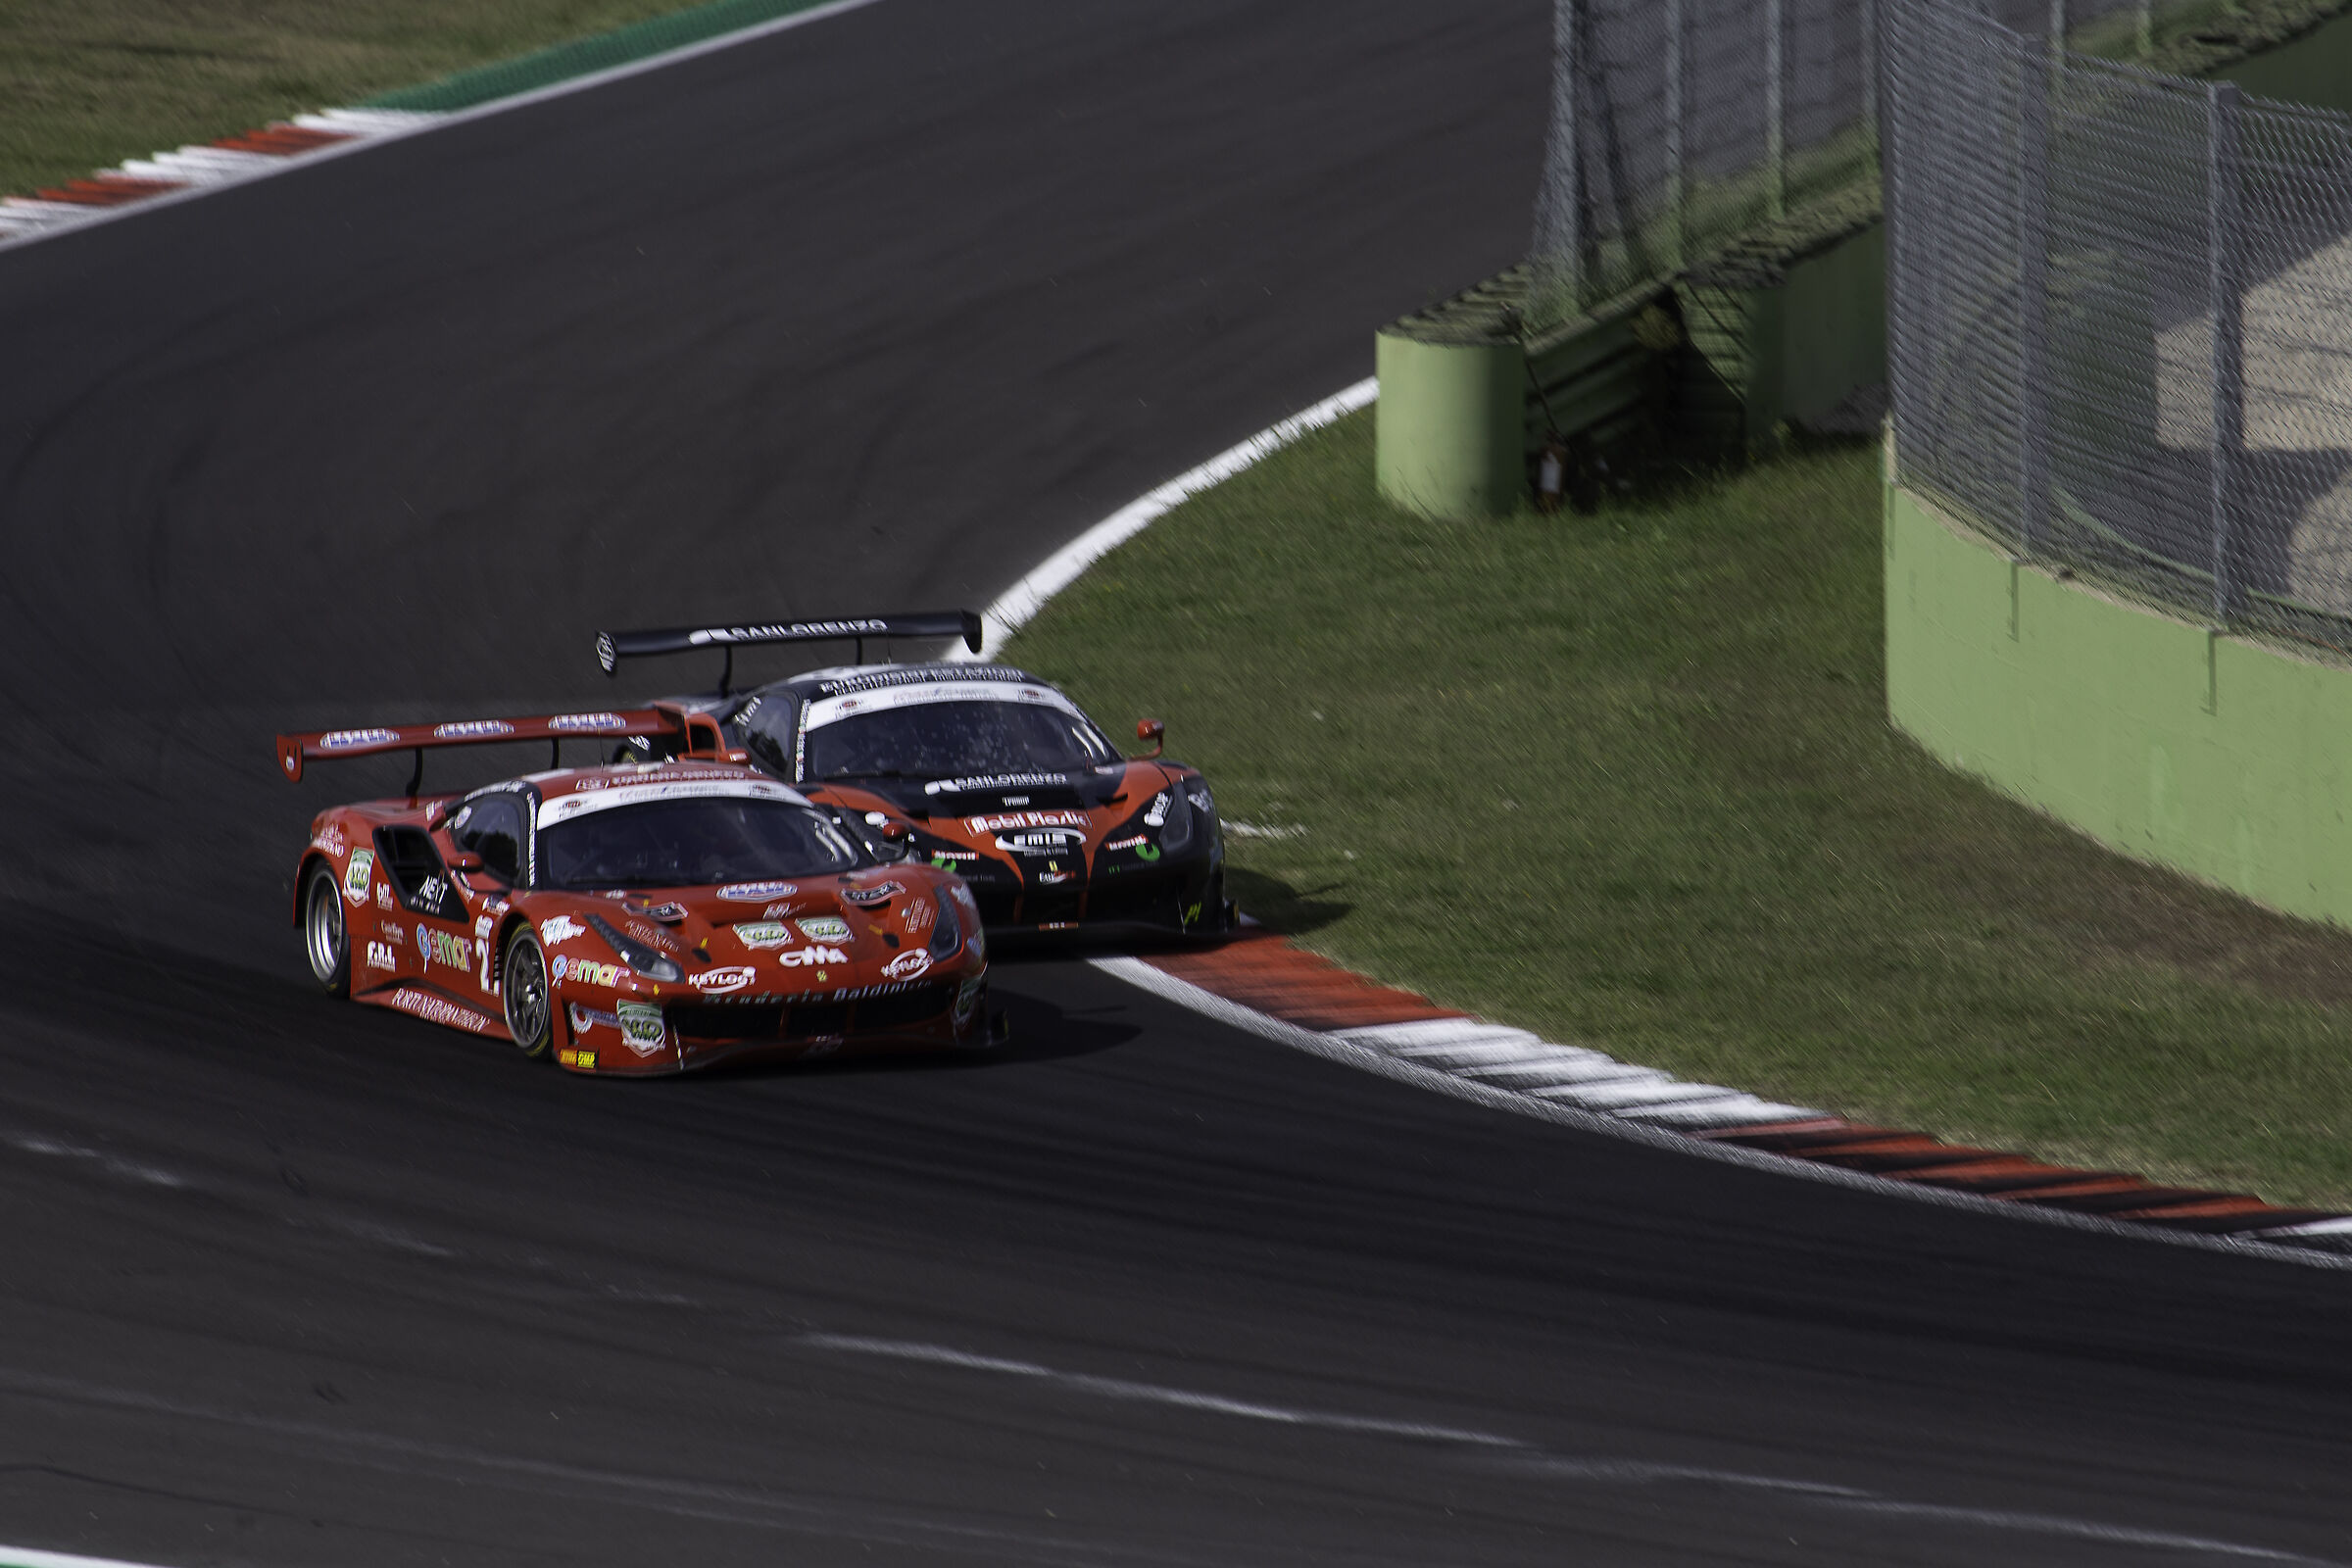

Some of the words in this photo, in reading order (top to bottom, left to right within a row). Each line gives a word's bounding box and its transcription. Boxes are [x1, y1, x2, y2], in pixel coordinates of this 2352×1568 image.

[728, 617, 889, 641] SANLORENZO
[970, 811, 1027, 834] Mobil
[832, 980, 907, 1003] Baldini
